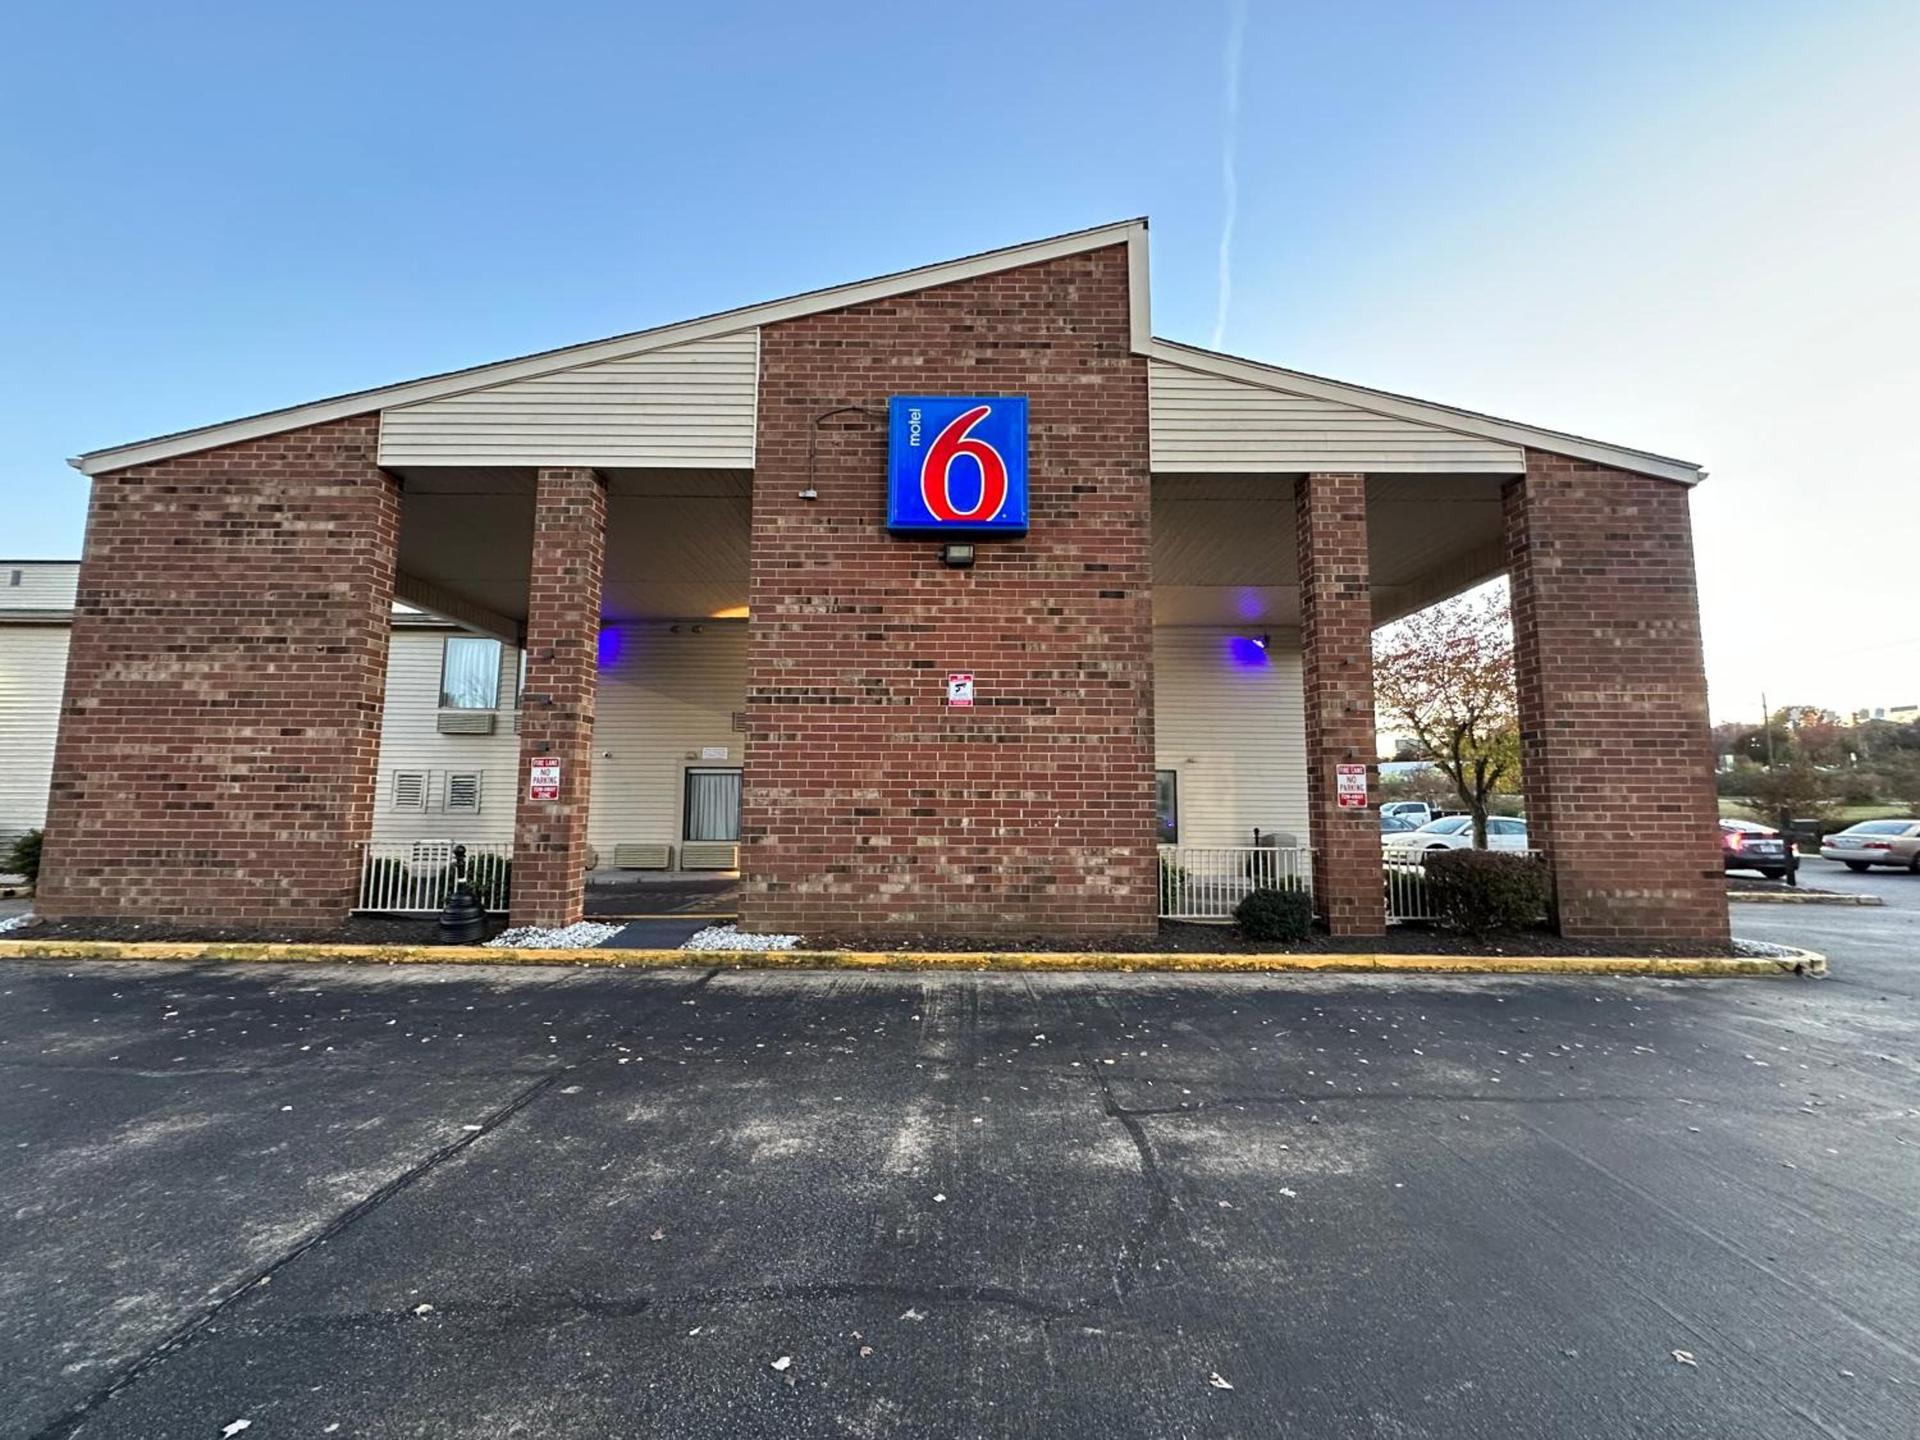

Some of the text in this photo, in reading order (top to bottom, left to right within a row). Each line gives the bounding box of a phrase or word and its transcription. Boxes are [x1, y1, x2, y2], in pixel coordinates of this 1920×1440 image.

[909, 409, 921, 446] motel
[920, 405, 1008, 521] 6
[540, 768, 551, 776] NO
[533, 776, 557, 784] PARKING
[1346, 776, 1357, 784] NO
